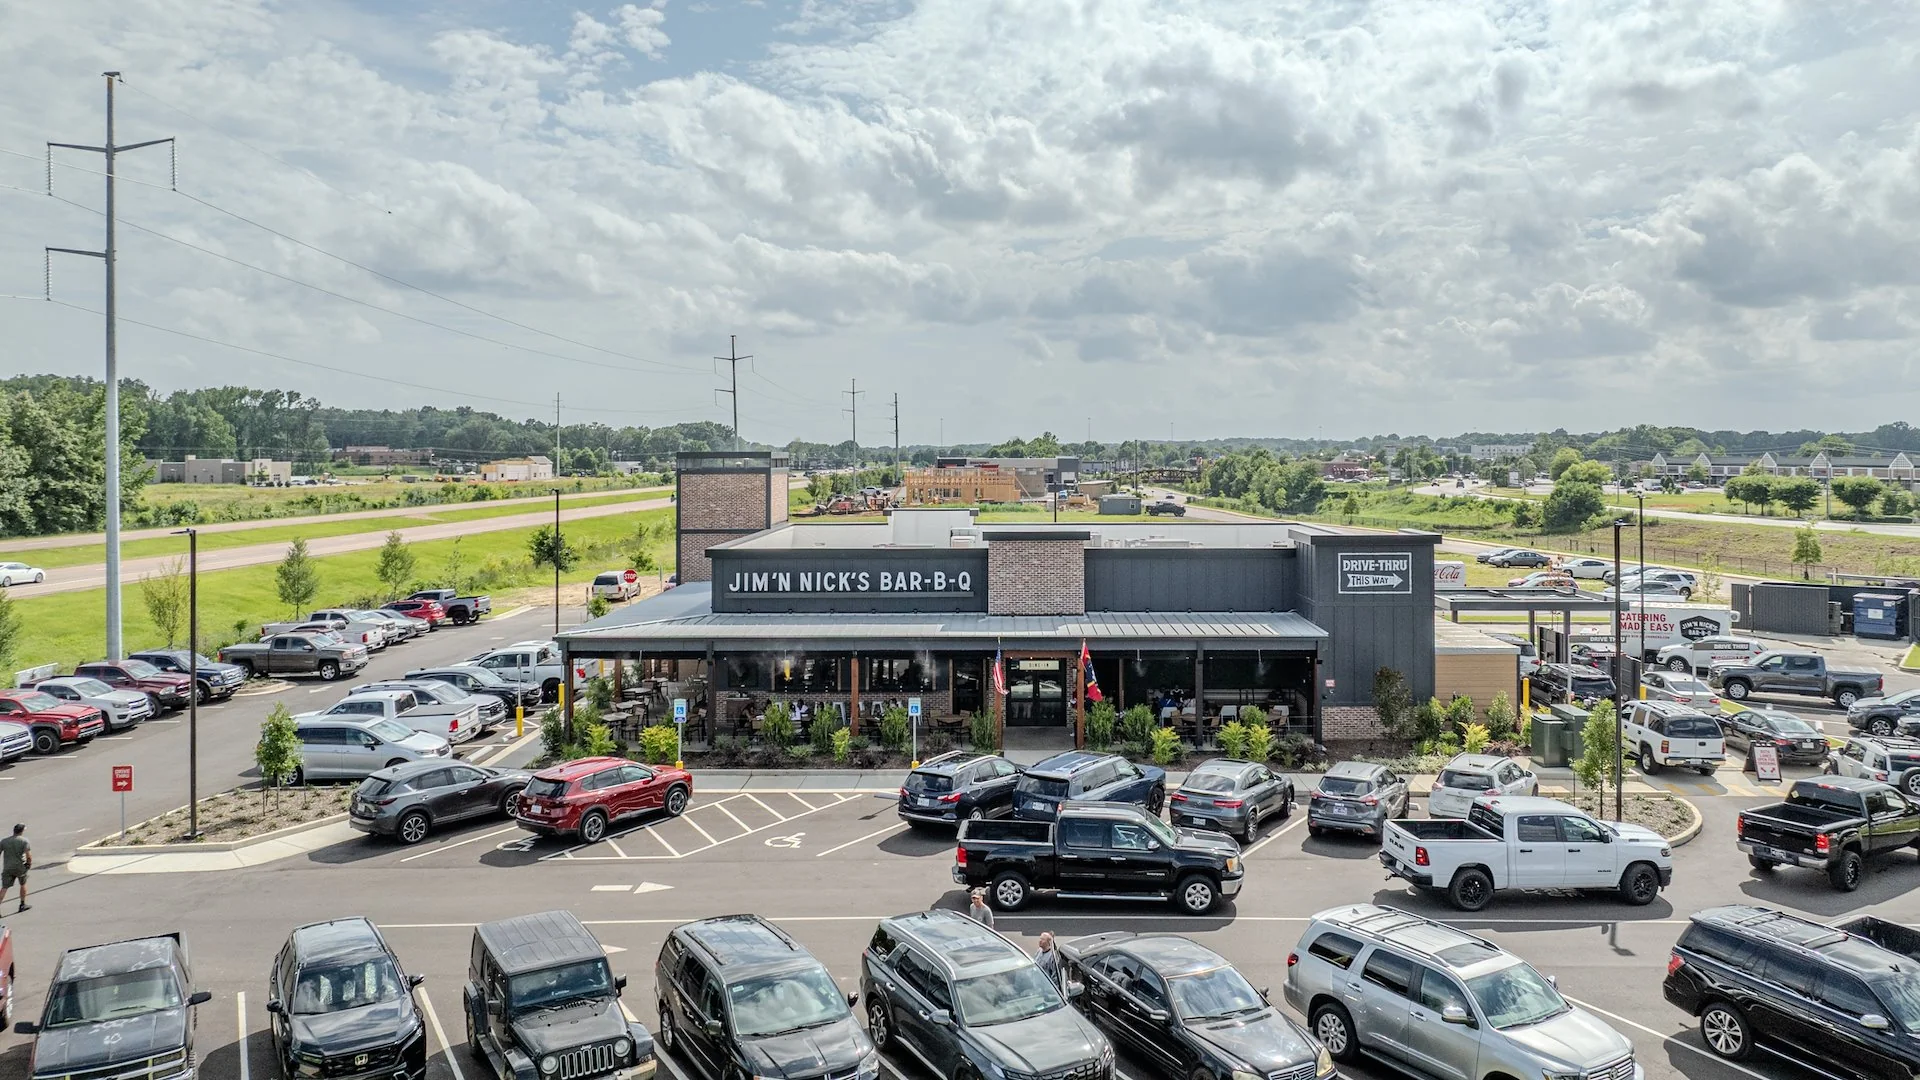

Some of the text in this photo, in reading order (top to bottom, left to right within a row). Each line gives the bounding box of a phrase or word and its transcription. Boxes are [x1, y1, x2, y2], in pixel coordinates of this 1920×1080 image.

[1342, 560, 1408, 571] DRIVE-THRU
[728, 571, 971, 592] JIM'N NICK'S BAR-B-Q
[1351, 575, 1389, 585] THIS WAY
[1620, 612, 1666, 622] CATERING
[1650, 623, 1675, 631] EASY
[1682, 621, 1719, 631] JIM'N NICK'S
